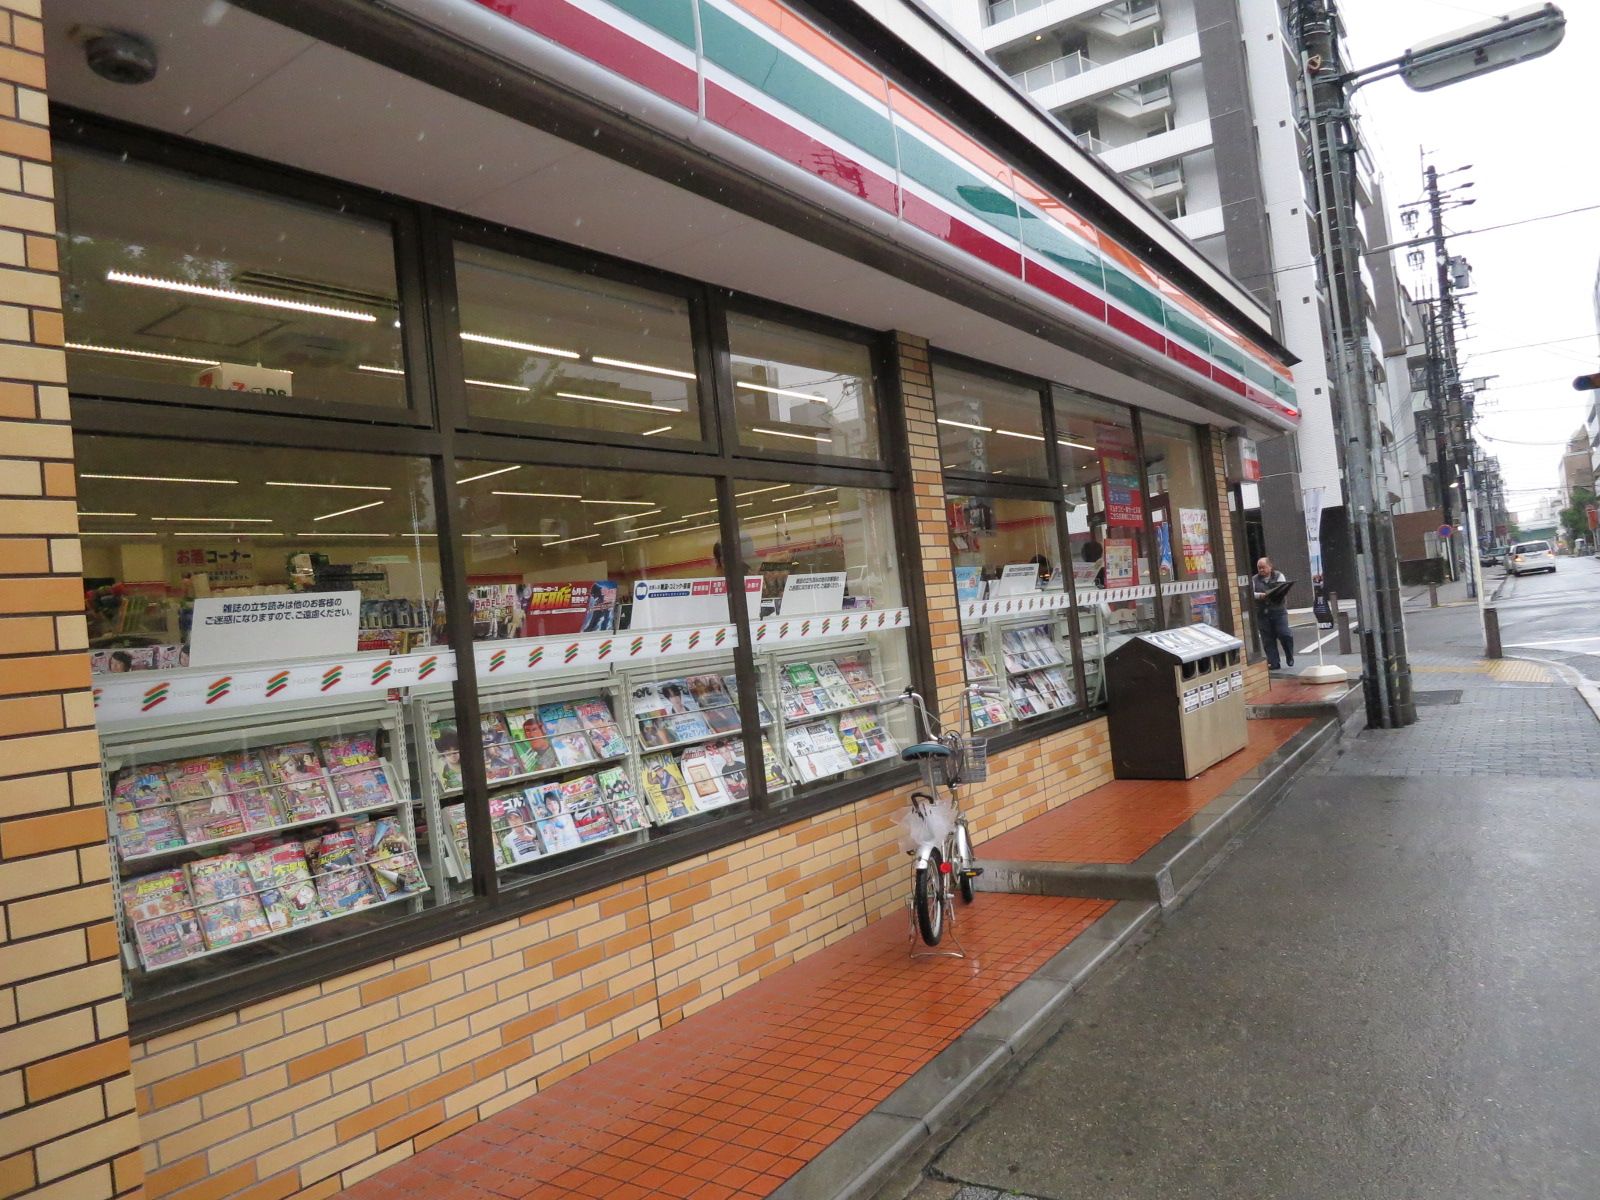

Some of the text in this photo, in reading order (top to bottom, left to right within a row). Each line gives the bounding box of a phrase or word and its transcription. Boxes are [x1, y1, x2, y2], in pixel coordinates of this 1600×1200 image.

[222, 598, 342, 613] 雑誌の立ち読みは他のお客様の
